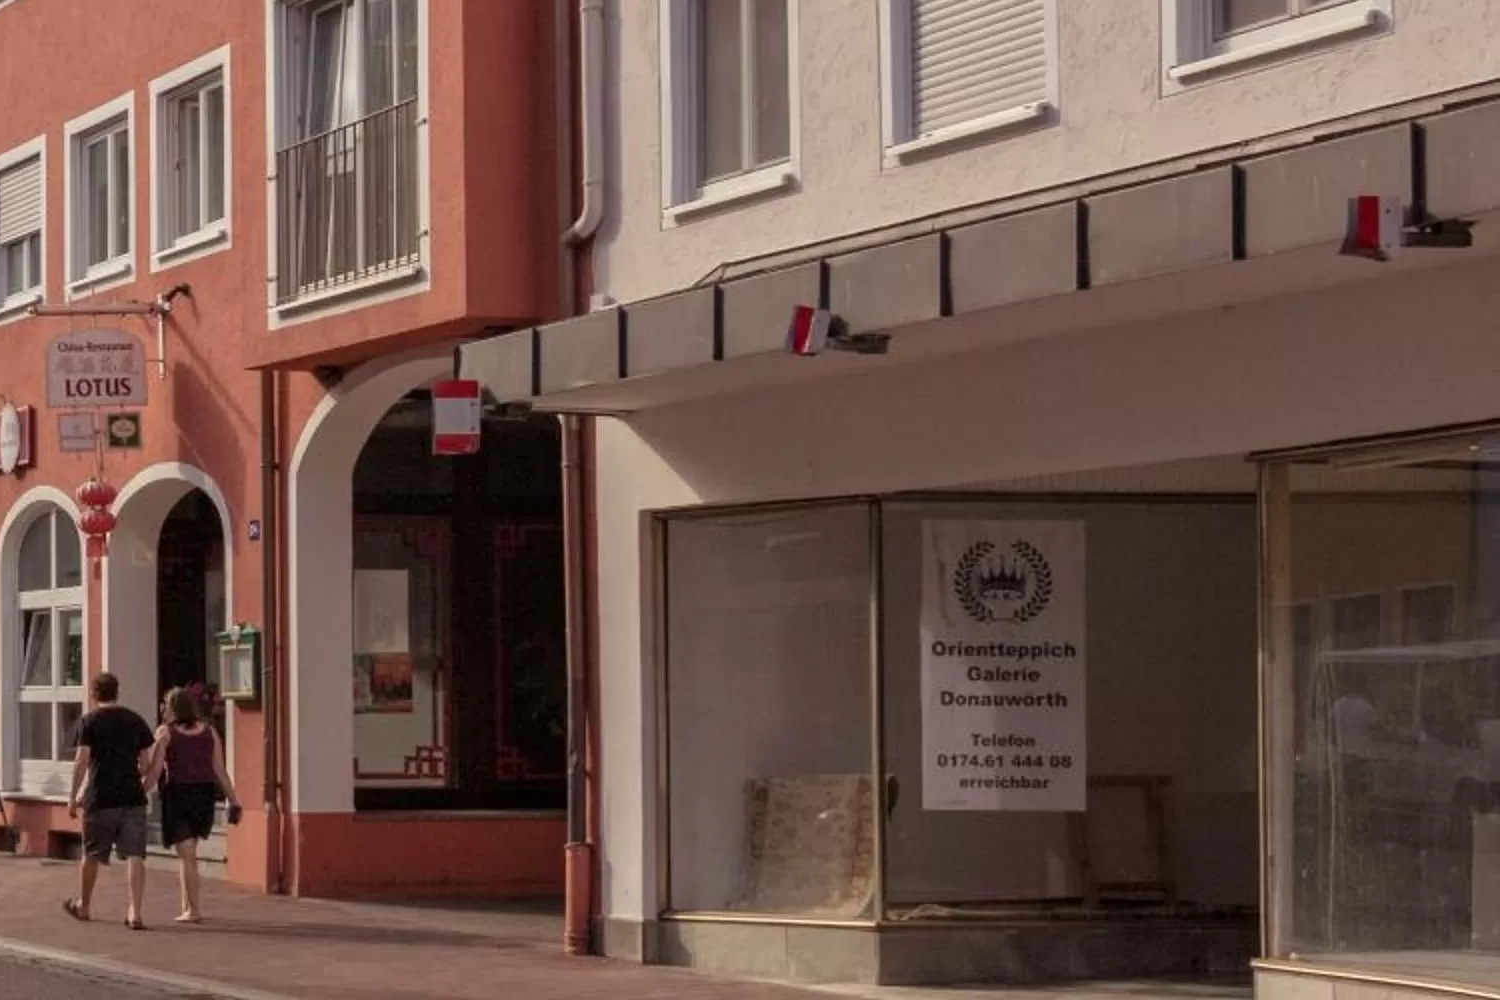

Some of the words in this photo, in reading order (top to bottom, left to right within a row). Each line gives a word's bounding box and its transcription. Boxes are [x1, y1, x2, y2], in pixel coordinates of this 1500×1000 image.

[65, 377, 132, 398] LOTUS
[931, 640, 1077, 661] Orientteppich
[966, 665, 1041, 682] Galerie
[971, 733, 1036, 748] Telefon
[1011, 754, 1044, 768] 444
[959, 775, 1049, 789] erreichbar
